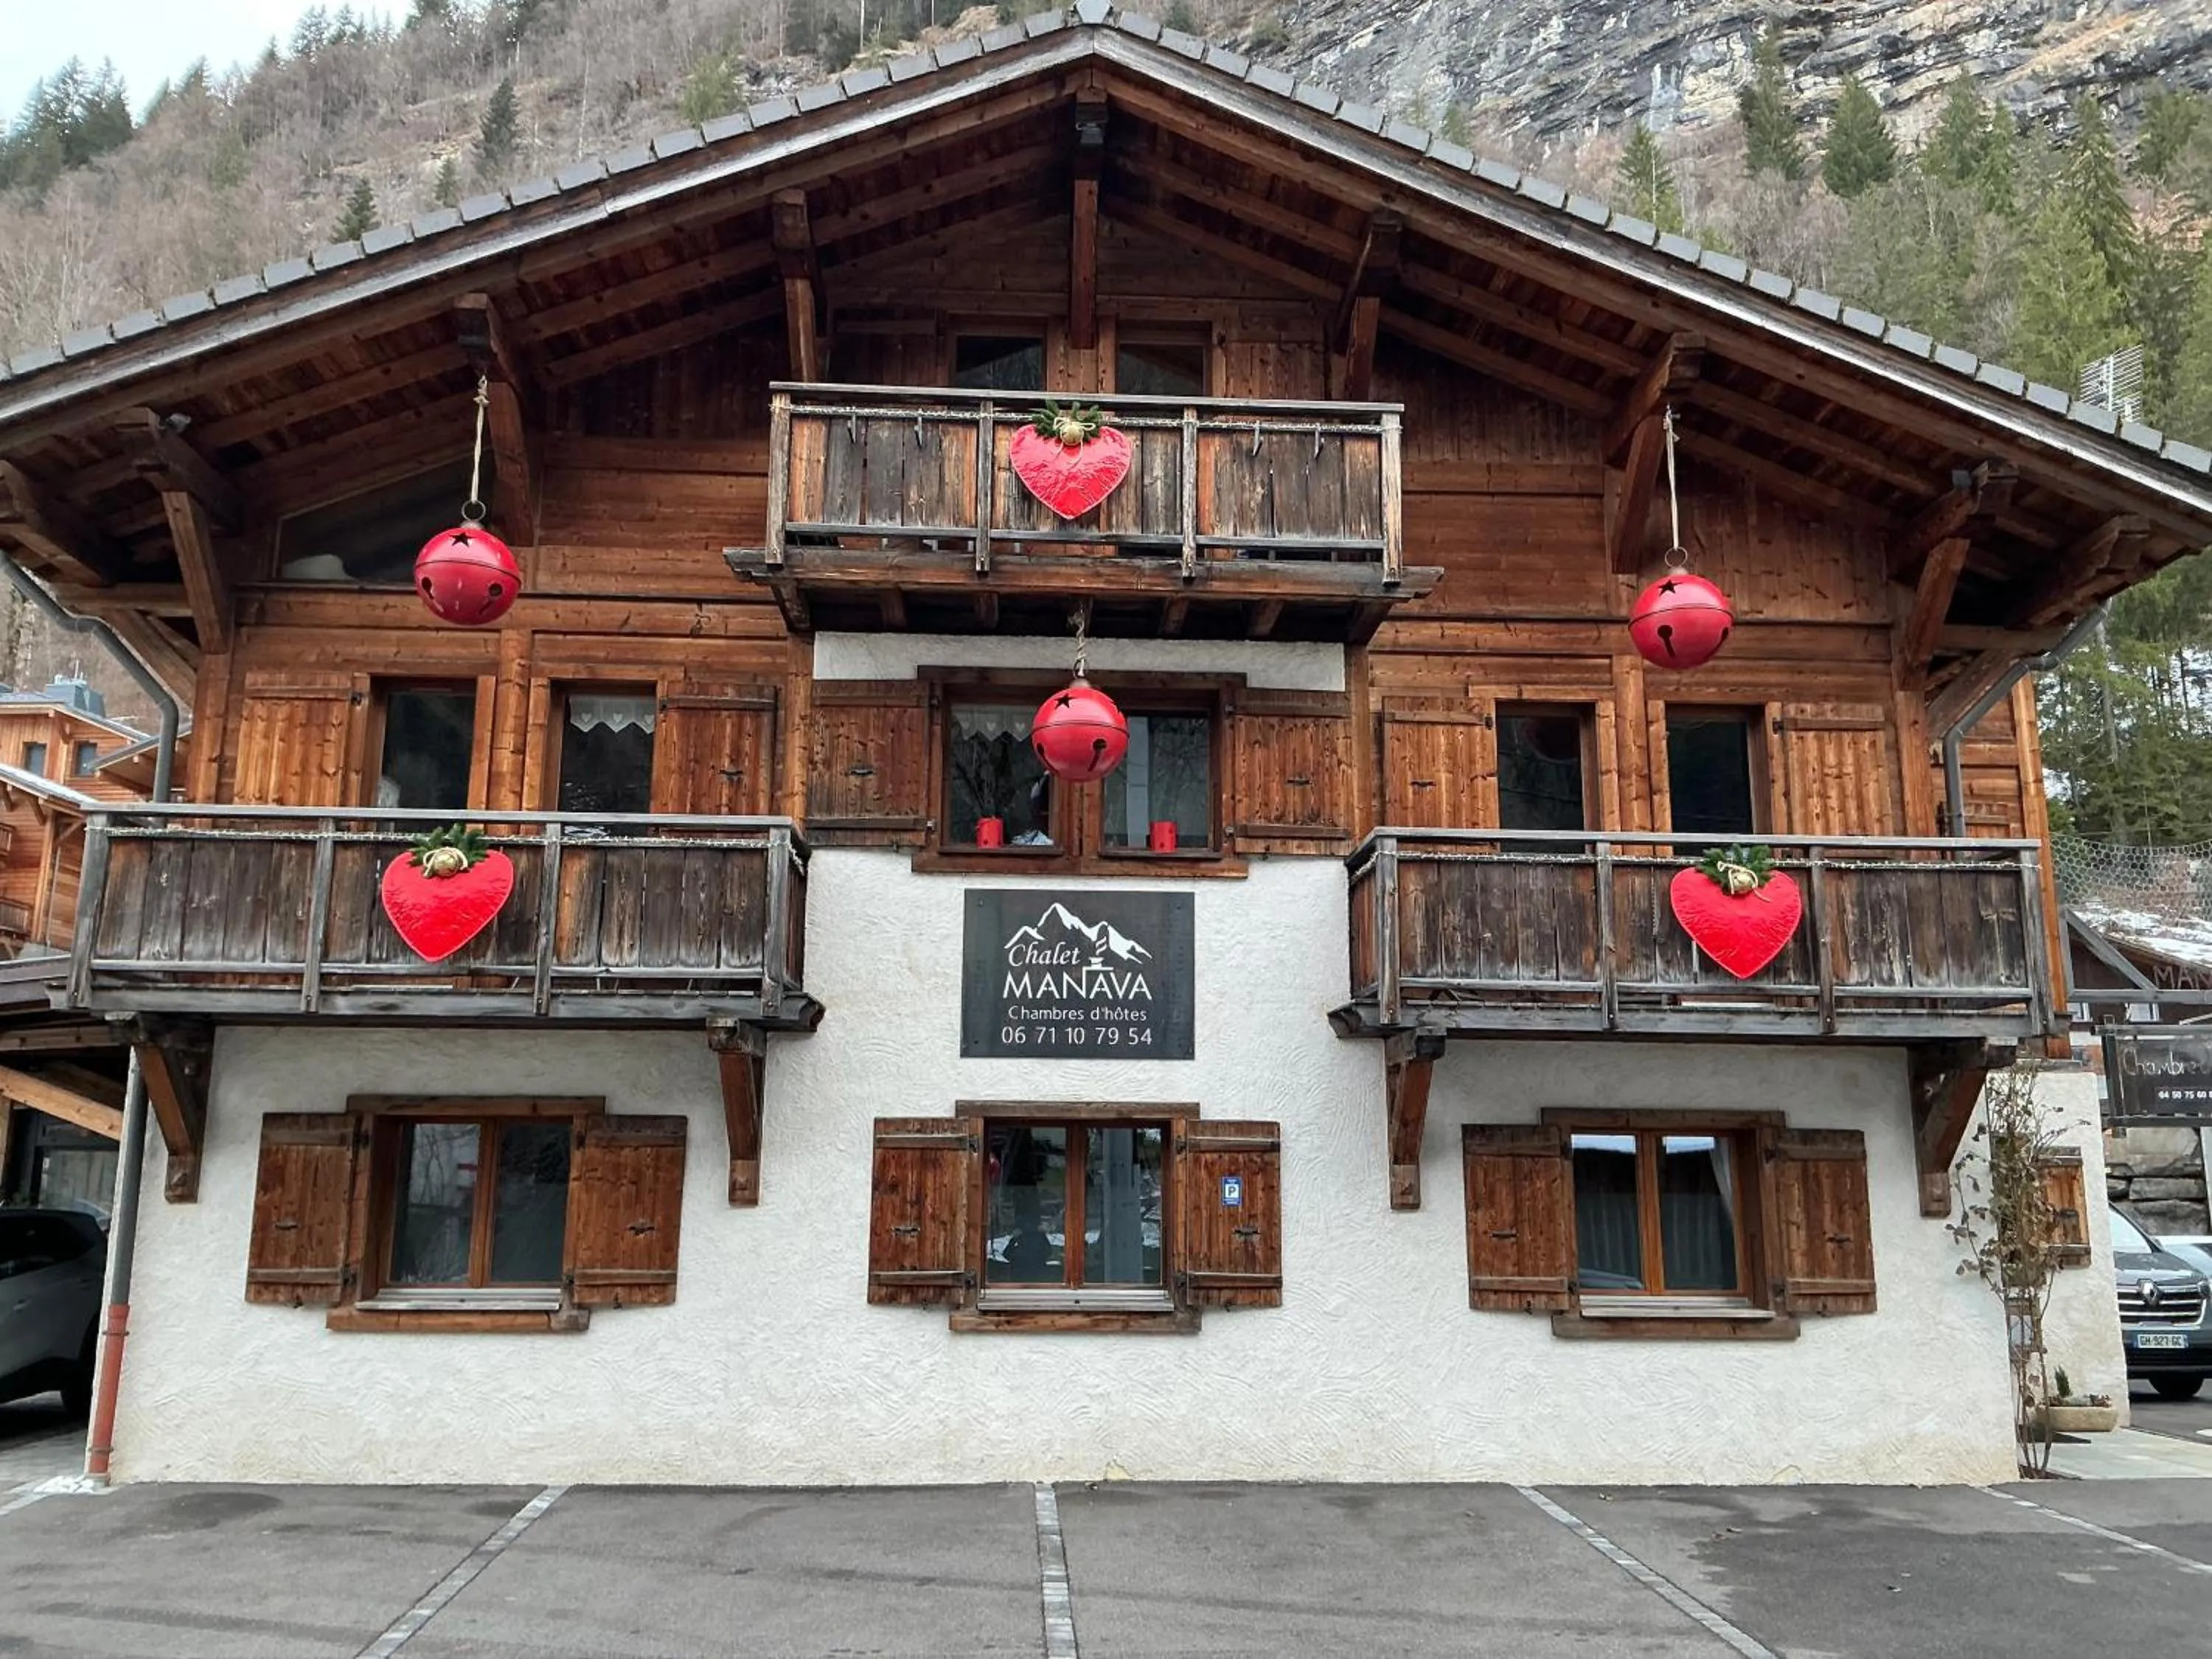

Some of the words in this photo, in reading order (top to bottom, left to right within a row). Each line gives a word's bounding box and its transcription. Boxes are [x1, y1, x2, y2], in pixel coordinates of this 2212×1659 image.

[1008, 942, 1081, 967] Chalet
[1002, 967, 1152, 1000] MANAVA
[1008, 1006, 1085, 1020] Chambres
[1091, 1006, 1147, 1021] d'hôtes
[1001, 1026, 1026, 1044] 06
[1035, 1026, 1056, 1044] 71
[1065, 1027, 1085, 1044] 10
[1095, 1027, 1119, 1044] 79
[1128, 1028, 1152, 1045] 54
[2171, 1091, 2182, 1099] 50
[2184, 1091, 2195, 1099] 75
[1228, 1186, 1237, 1196] P
